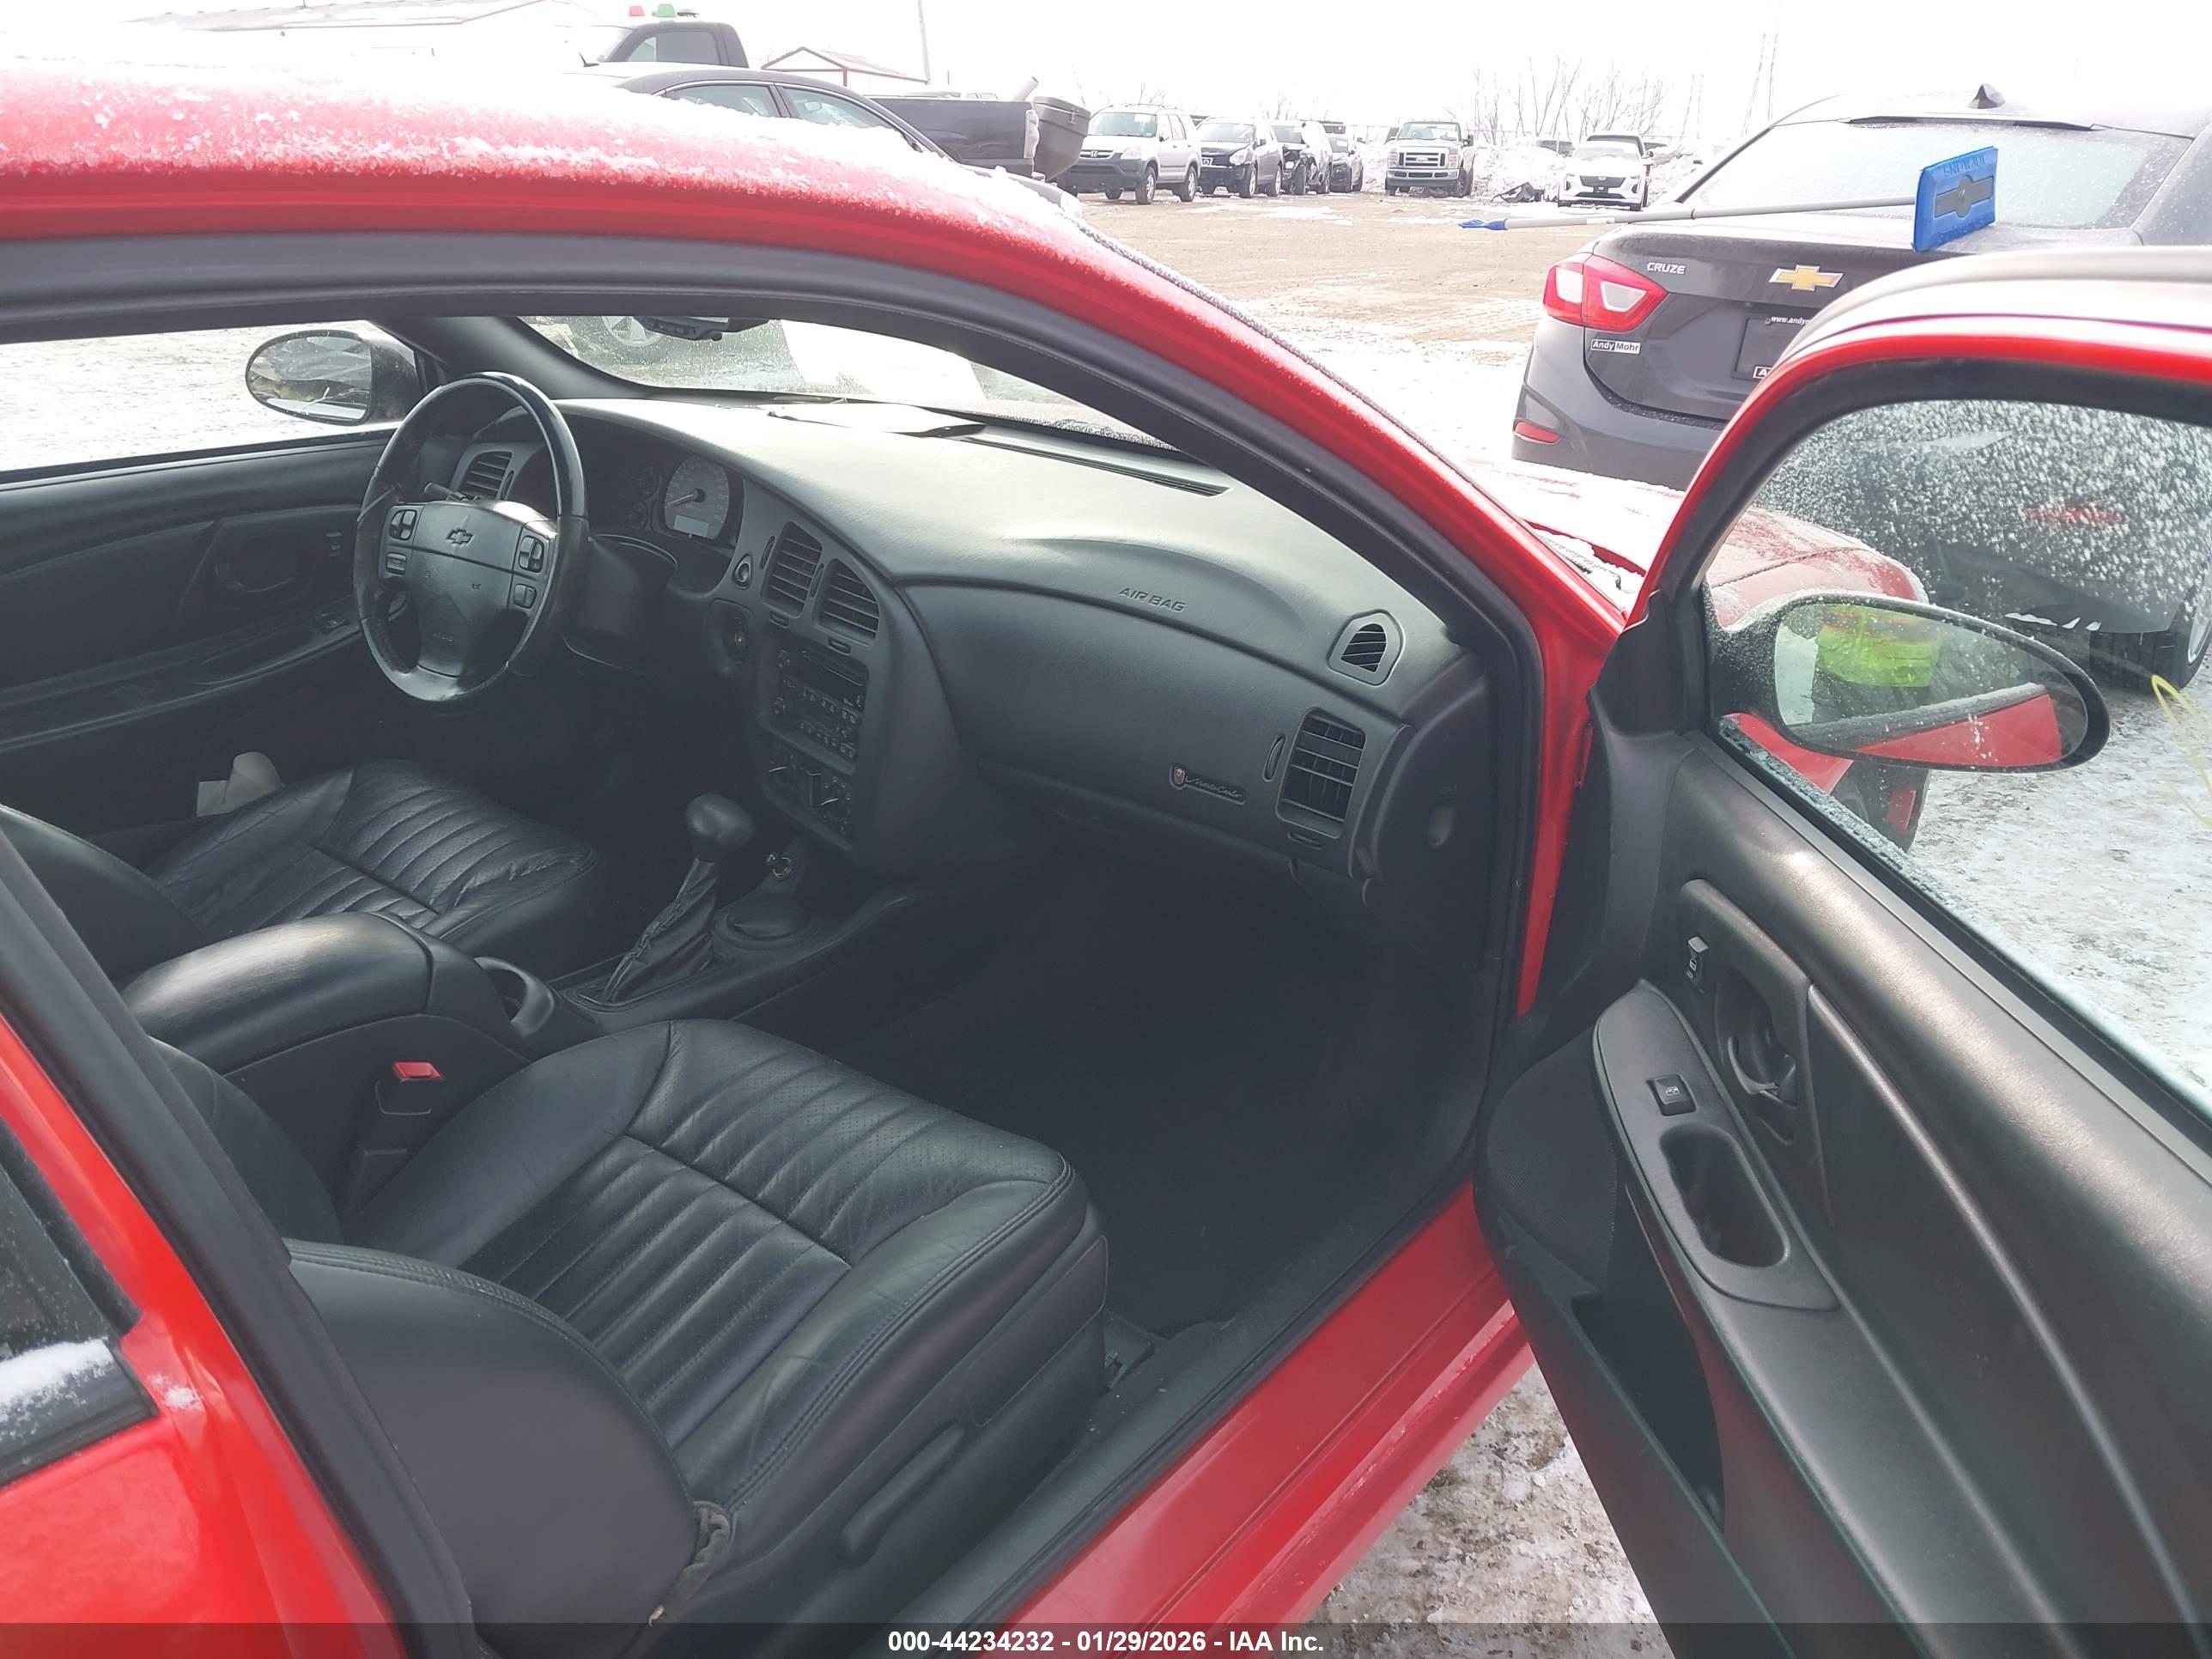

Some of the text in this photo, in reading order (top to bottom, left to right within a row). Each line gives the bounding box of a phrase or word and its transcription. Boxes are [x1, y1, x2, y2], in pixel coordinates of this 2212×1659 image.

[1647, 262, 1686, 275] CRUZE
[1592, 341, 1639, 353] Andy Mohr
[1118, 587, 1187, 613] AIR BAG
